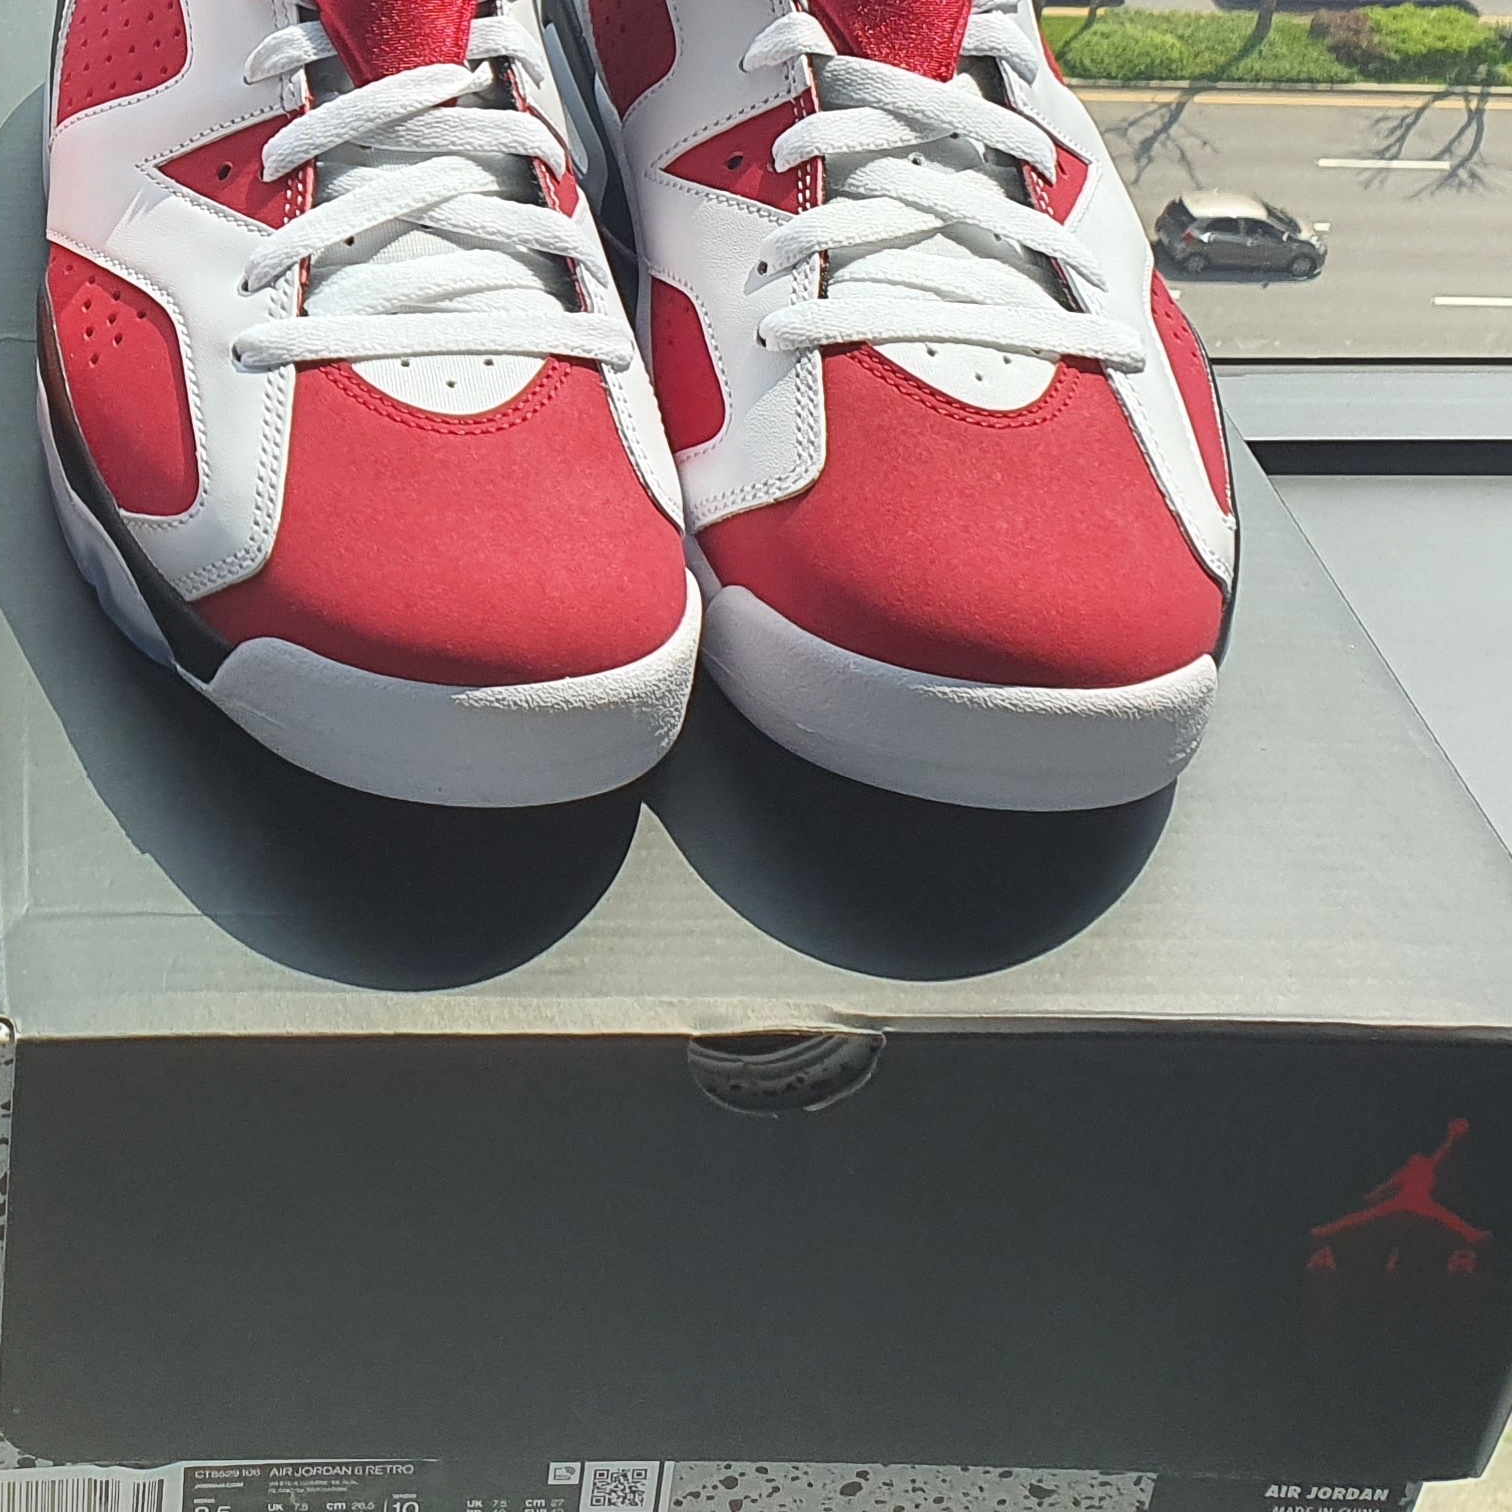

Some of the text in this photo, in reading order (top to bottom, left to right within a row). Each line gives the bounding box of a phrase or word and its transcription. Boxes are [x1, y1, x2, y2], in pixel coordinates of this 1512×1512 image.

[269, 1466, 293, 1477] AIR
[294, 1465, 352, 1477] JORDAN
[365, 1464, 415, 1476] RETRO
[1264, 1484, 1390, 1501] AIR JORDAN
